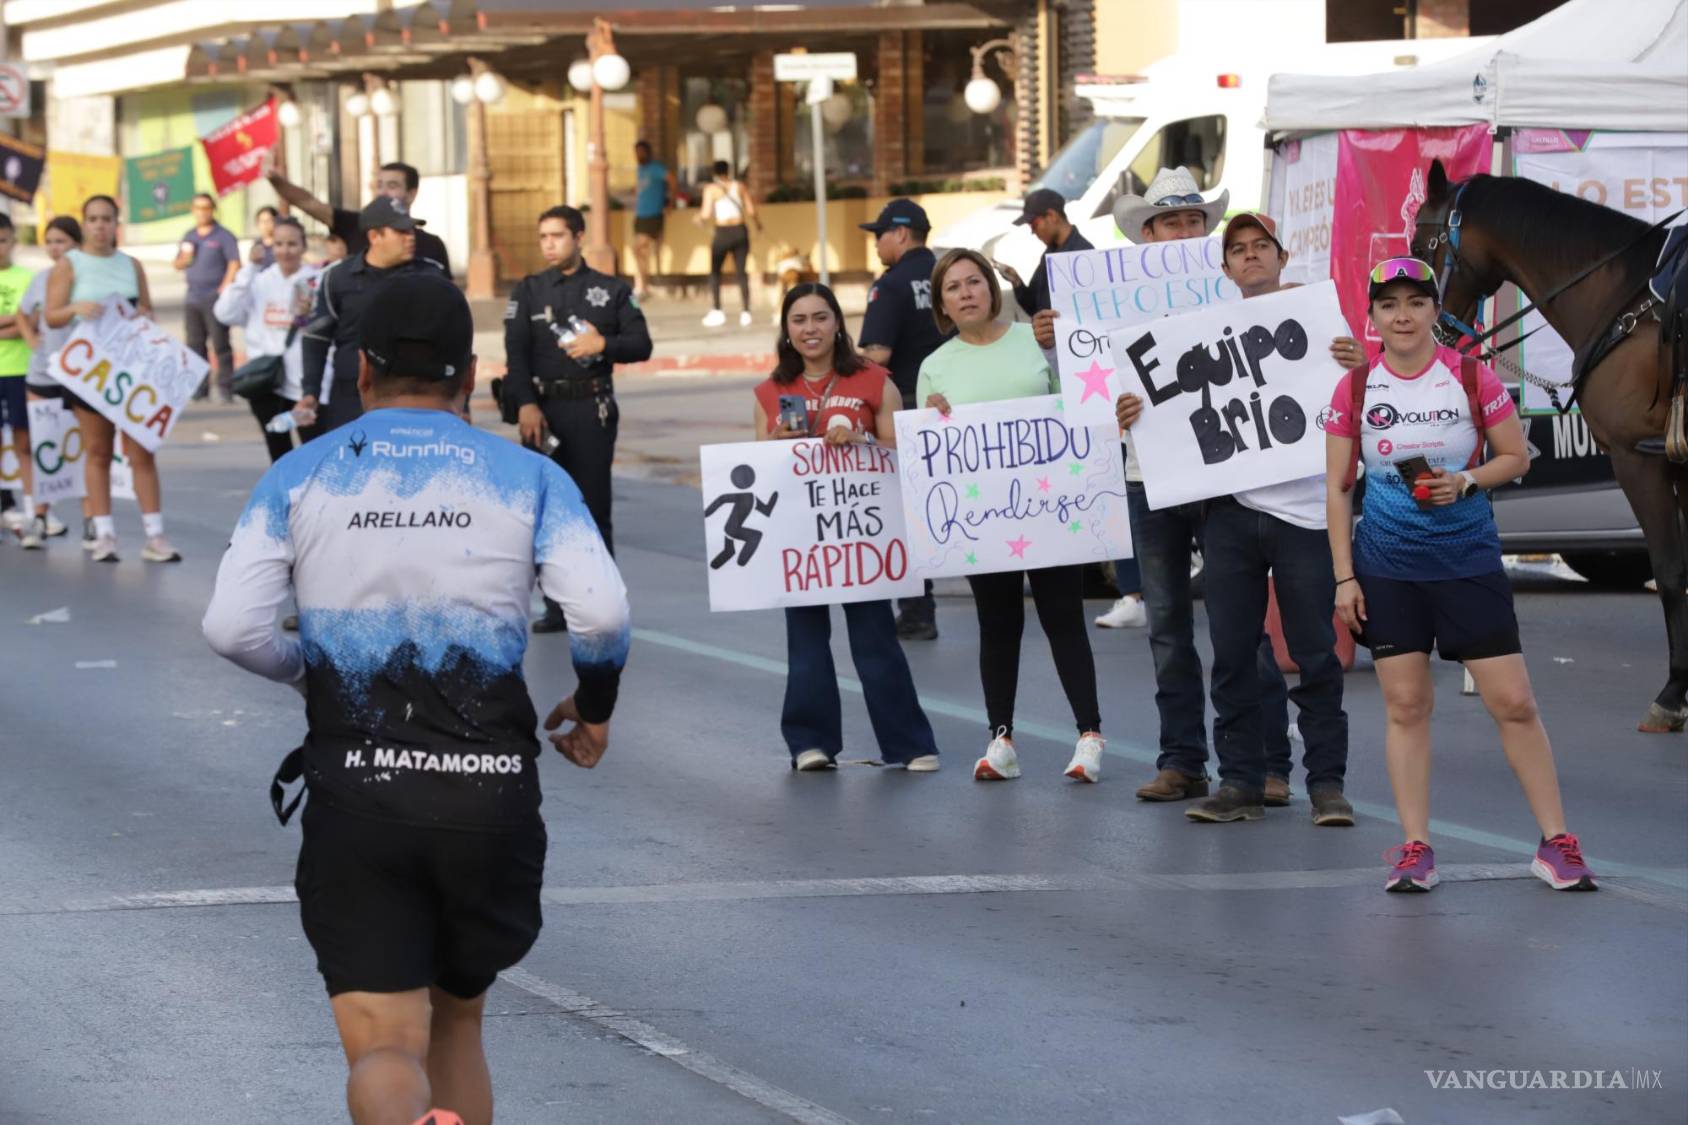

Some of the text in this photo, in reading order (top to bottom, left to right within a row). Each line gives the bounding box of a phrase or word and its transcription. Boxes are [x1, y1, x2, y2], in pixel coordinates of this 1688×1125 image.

[1047, 252, 1097, 293] NO
[1102, 248, 1140, 283] TE
[1071, 283, 1160, 325] PERO
[1126, 318, 1308, 409] Equipo
[60, 338, 175, 438] CASCA
[1189, 391, 1307, 465] Brio
[372, 441, 476, 465] Running
[804, 477, 881, 508] TE HACE
[926, 478, 1110, 545] Rendirse
[347, 511, 472, 530] ARELLANO
[816, 502, 883, 541] MÁS
[782, 538, 908, 592] RÁPIDO
[345, 748, 523, 773] H. MATAMOROS
